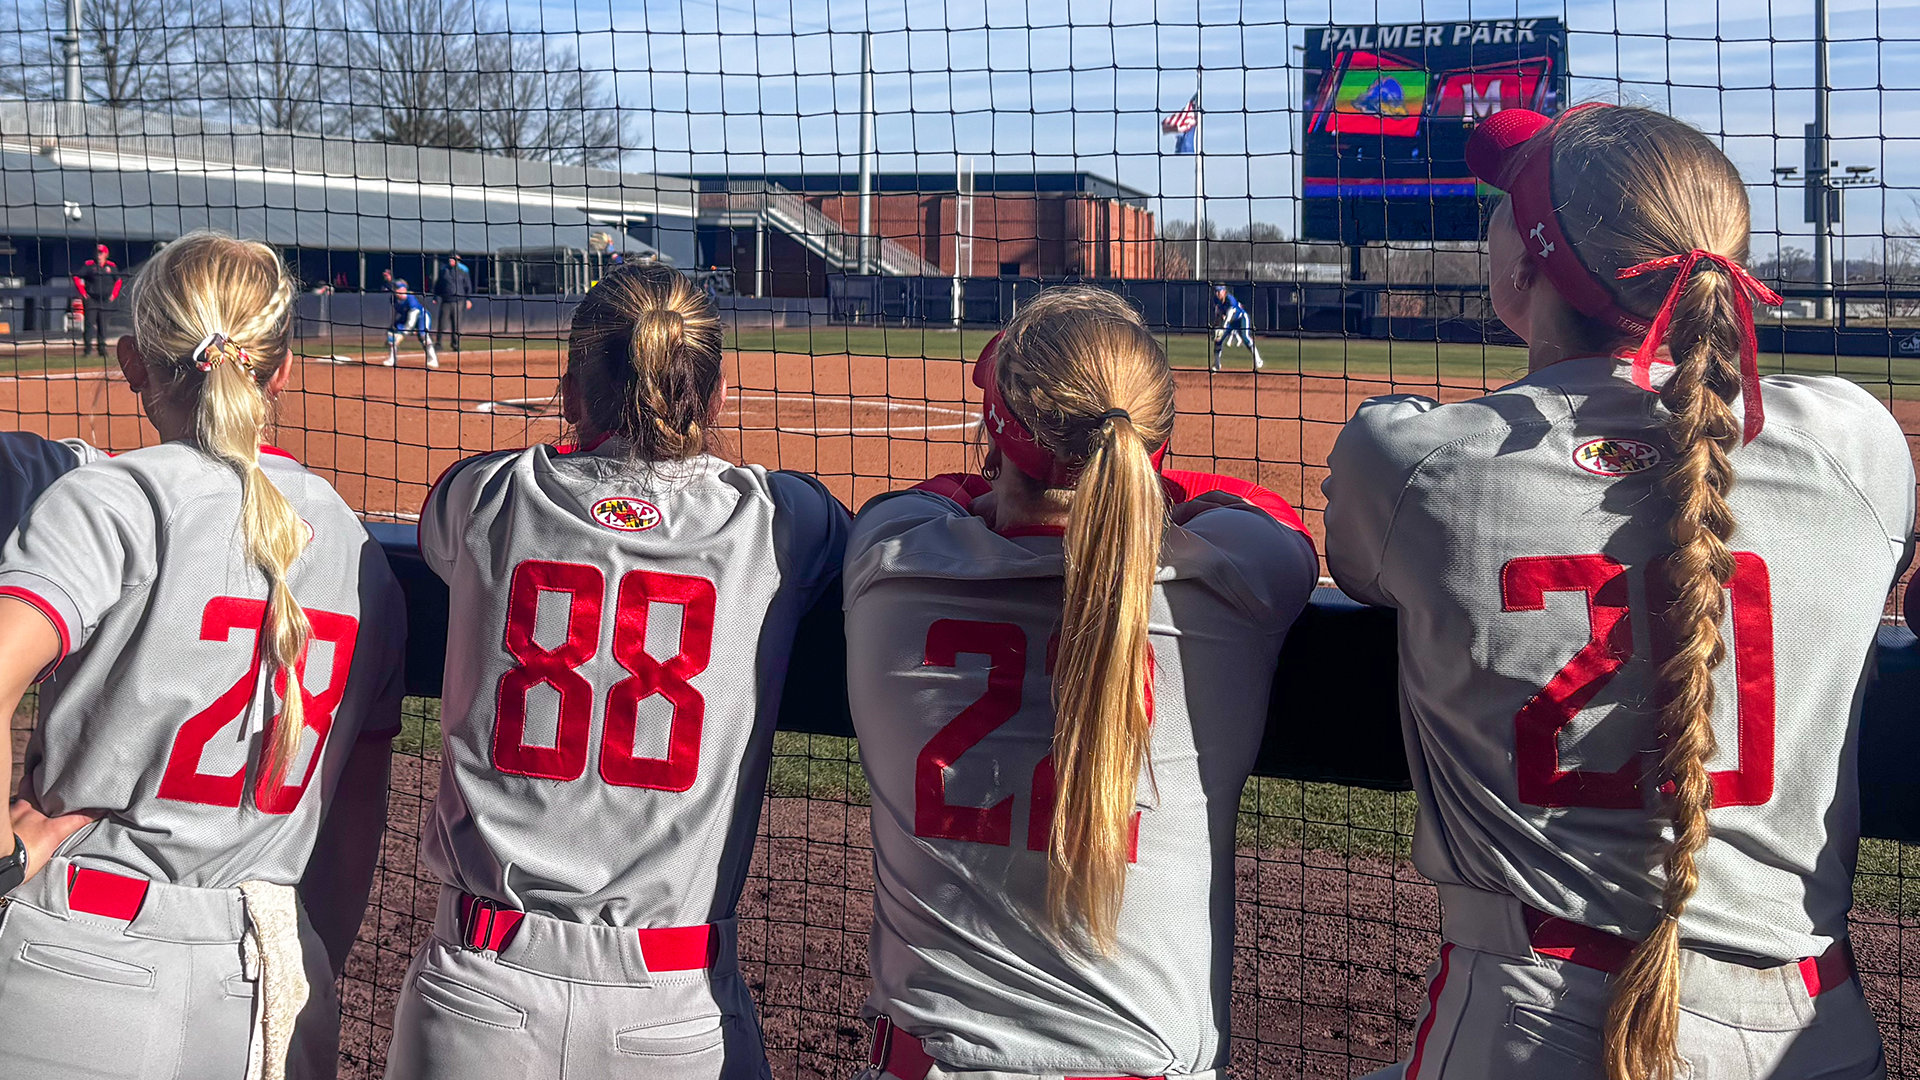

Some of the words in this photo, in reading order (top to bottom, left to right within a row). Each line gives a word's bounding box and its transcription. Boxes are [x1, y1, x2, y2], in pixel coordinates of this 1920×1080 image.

[1320, 25, 1444, 51] PALMER
[1452, 19, 1538, 46] PARK
[1461, 79, 1502, 123] M
[156, 596, 359, 814] 28
[493, 559, 717, 792] 88
[1501, 551, 1775, 809] 20
